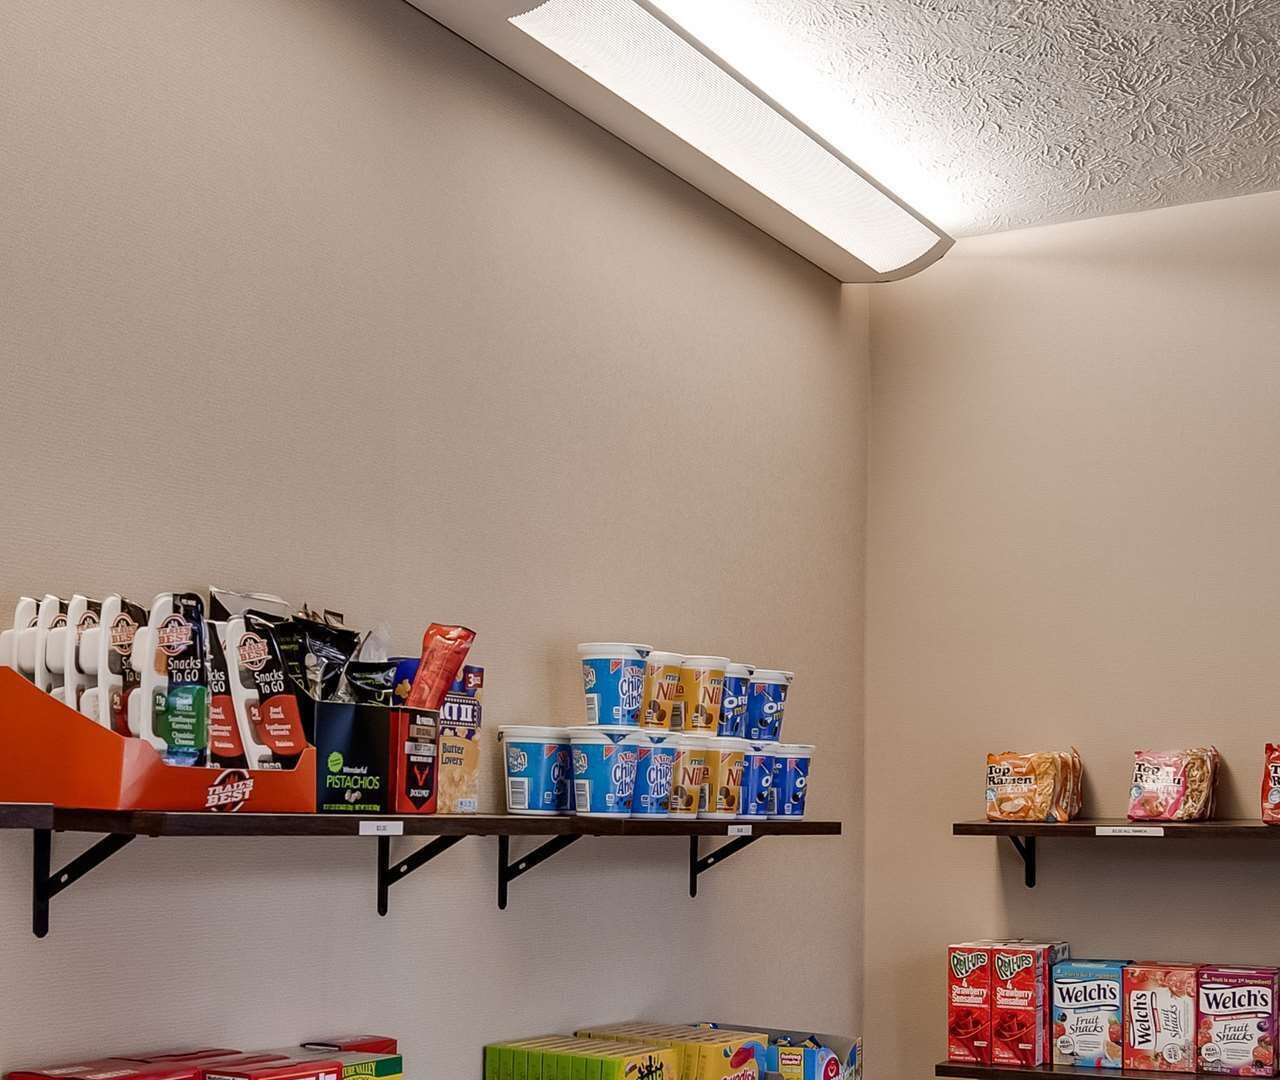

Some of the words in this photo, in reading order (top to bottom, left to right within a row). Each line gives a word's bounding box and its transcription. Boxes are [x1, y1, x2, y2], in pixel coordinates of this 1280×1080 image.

[168, 656, 201, 670] Snacks
[171, 669, 184, 682] To
[184, 669, 200, 682] GO
[254, 669, 284, 684] Snacks
[270, 680, 285, 693] GO
[442, 742, 465, 755] Butter
[441, 754, 464, 767] Lovers
[988, 765, 1011, 778] Top
[1135, 762, 1160, 775] Top
[326, 775, 380, 790] PISTACHIOS
[988, 776, 1033, 786] Ramen
[1057, 984, 1118, 1004] Welch's
[1204, 990, 1270, 1010] Welch's
[1075, 1015, 1100, 1026] Fruit
[1133, 992, 1149, 1046] Welch's
[1162, 1009, 1172, 1033] Fruit
[1169, 1003, 1182, 1040] Snacks
[1069, 1022, 1105, 1035] Snacks
[1222, 1022, 1249, 1035] Fruit
[1216, 1031, 1254, 1043] Snacks
[354, 1062, 376, 1076] VALLEY
